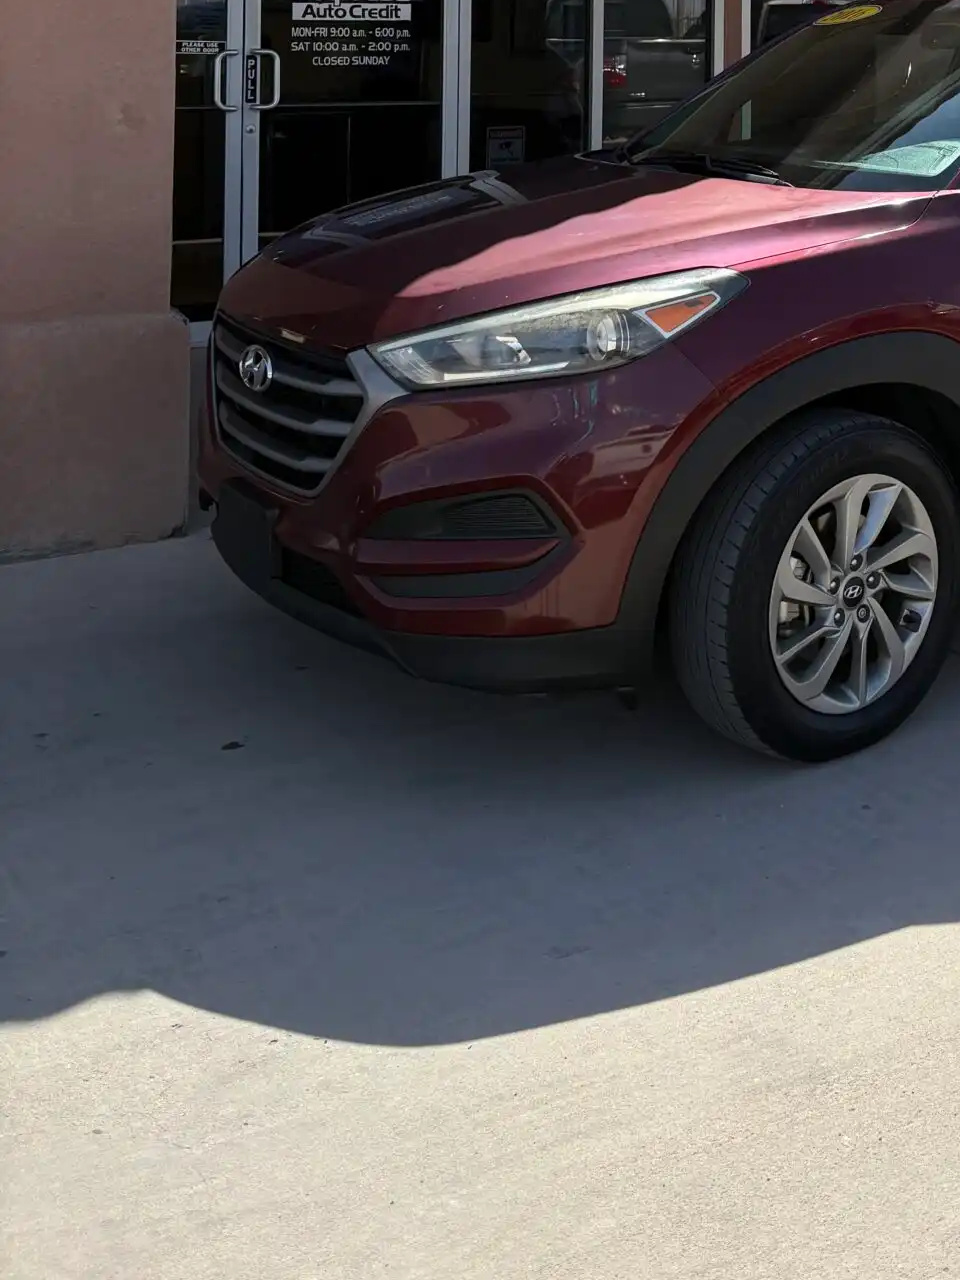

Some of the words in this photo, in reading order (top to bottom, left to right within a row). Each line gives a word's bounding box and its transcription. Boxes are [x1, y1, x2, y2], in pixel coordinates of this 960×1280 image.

[302, 4, 347, 19] Auto
[349, 4, 402, 19] Credit
[291, 26, 328, 38] MON-FRI
[330, 26, 350, 37] 9:00
[352, 28, 367, 37] a.m.
[375, 26, 395, 37] 6:00
[396, 28, 412, 39] p.m.
[291, 41, 310, 51] SAT
[313, 41, 339, 51] 10:00
[341, 43, 359, 51] a.m.
[368, 41, 392, 51] 2:00
[394, 43, 411, 53] p.m.
[312, 56, 350, 66] CLOSED
[351, 55, 391, 66] SUNDAY
[247, 59, 256, 100] PULL
